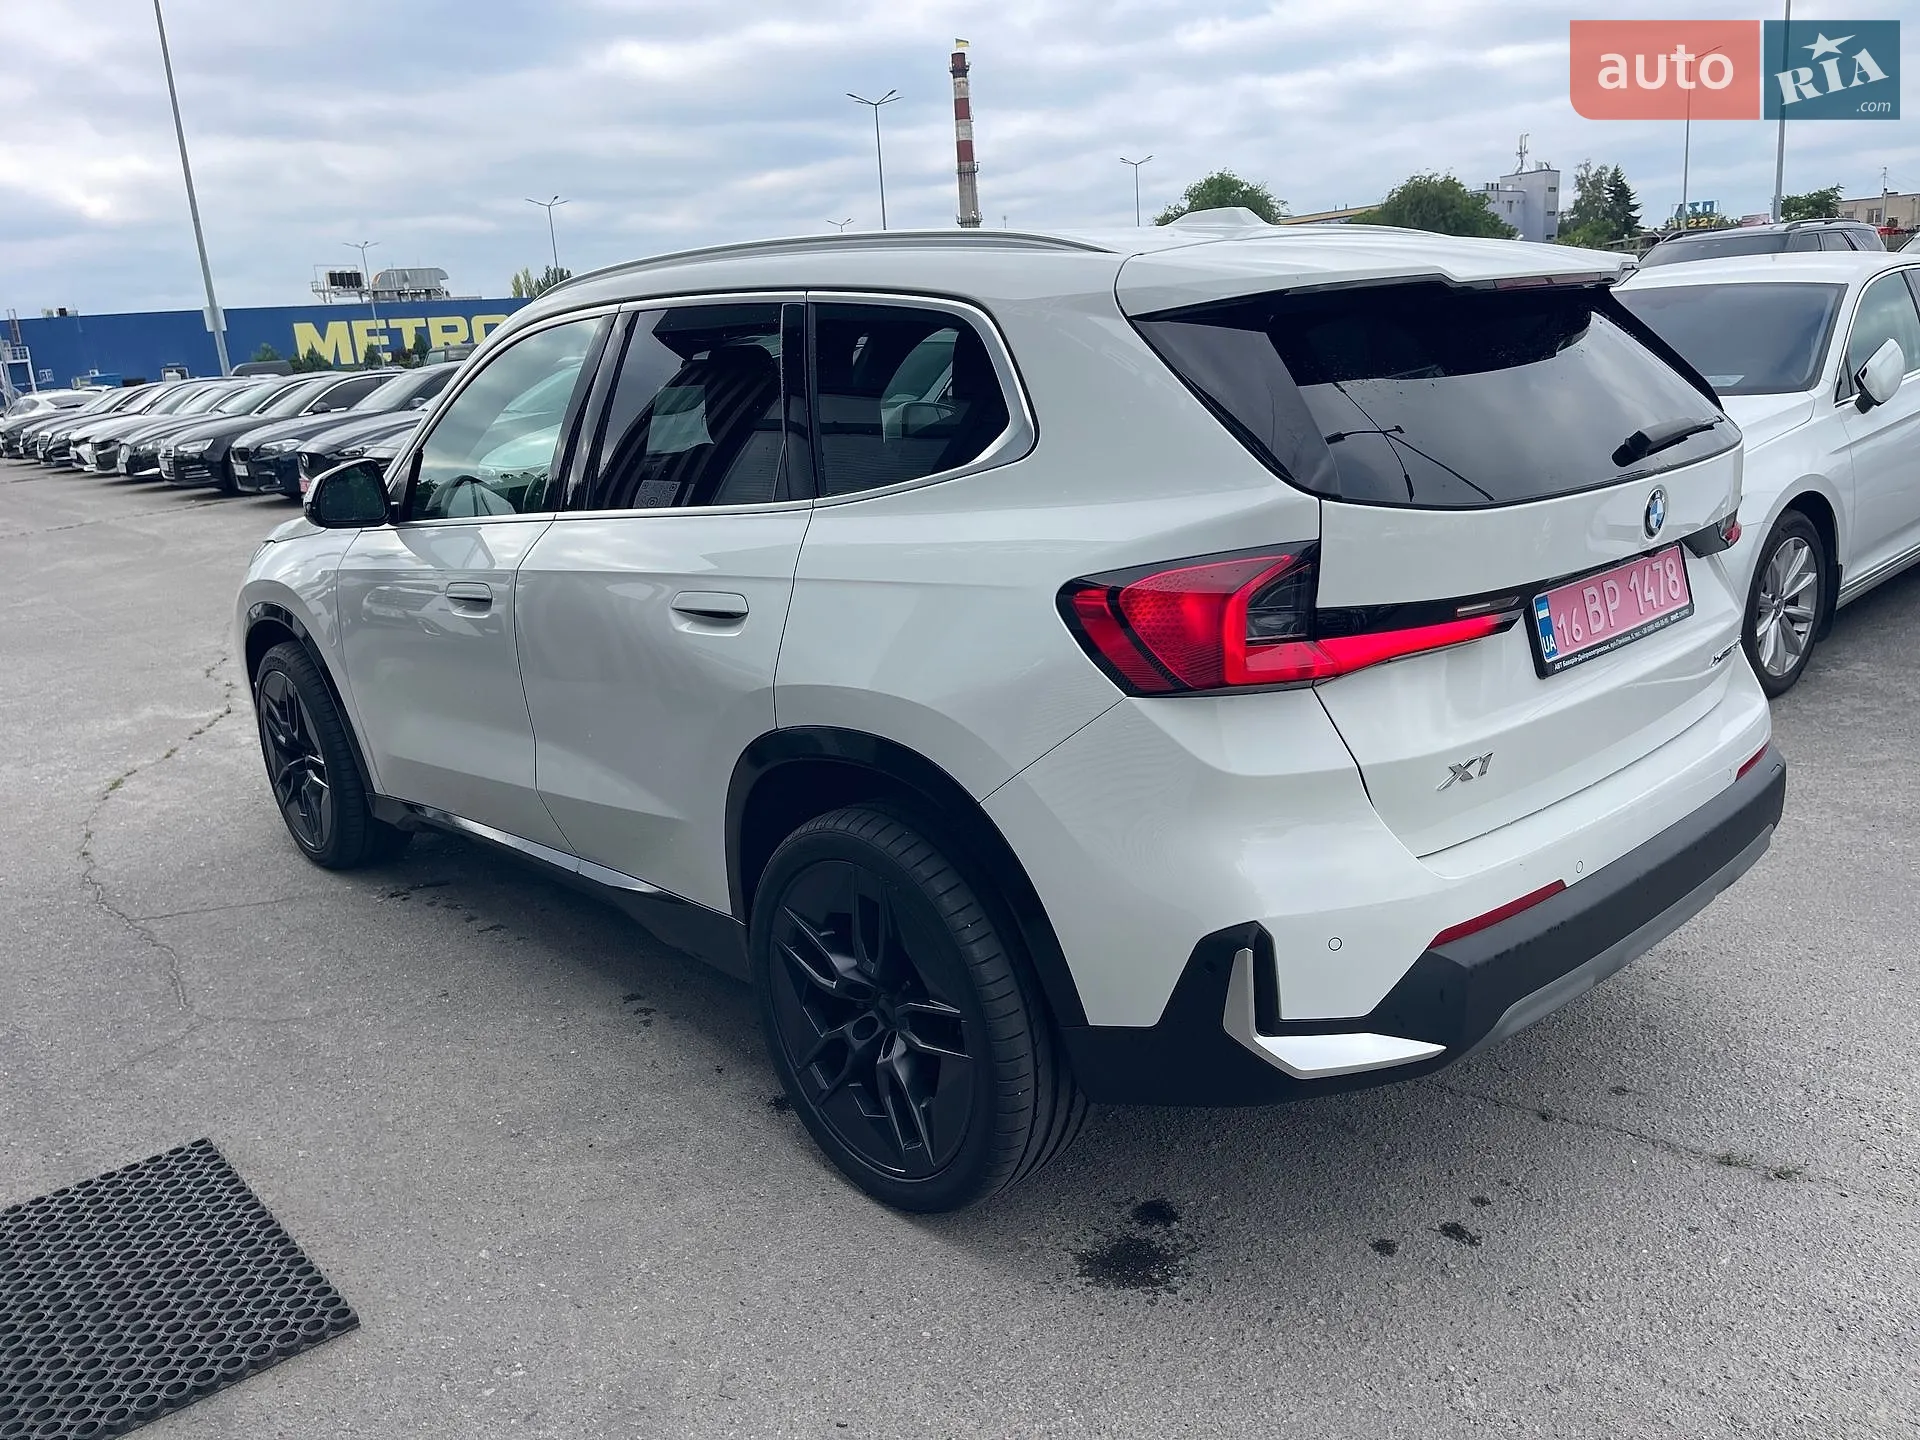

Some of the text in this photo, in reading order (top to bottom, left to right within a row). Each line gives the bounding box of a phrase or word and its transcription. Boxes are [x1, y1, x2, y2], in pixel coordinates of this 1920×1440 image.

[1556, 607, 1584, 648] 16
[1629, 557, 1682, 616] 1478
[1541, 635, 1557, 654] UA
[1436, 752, 1494, 791] X1
